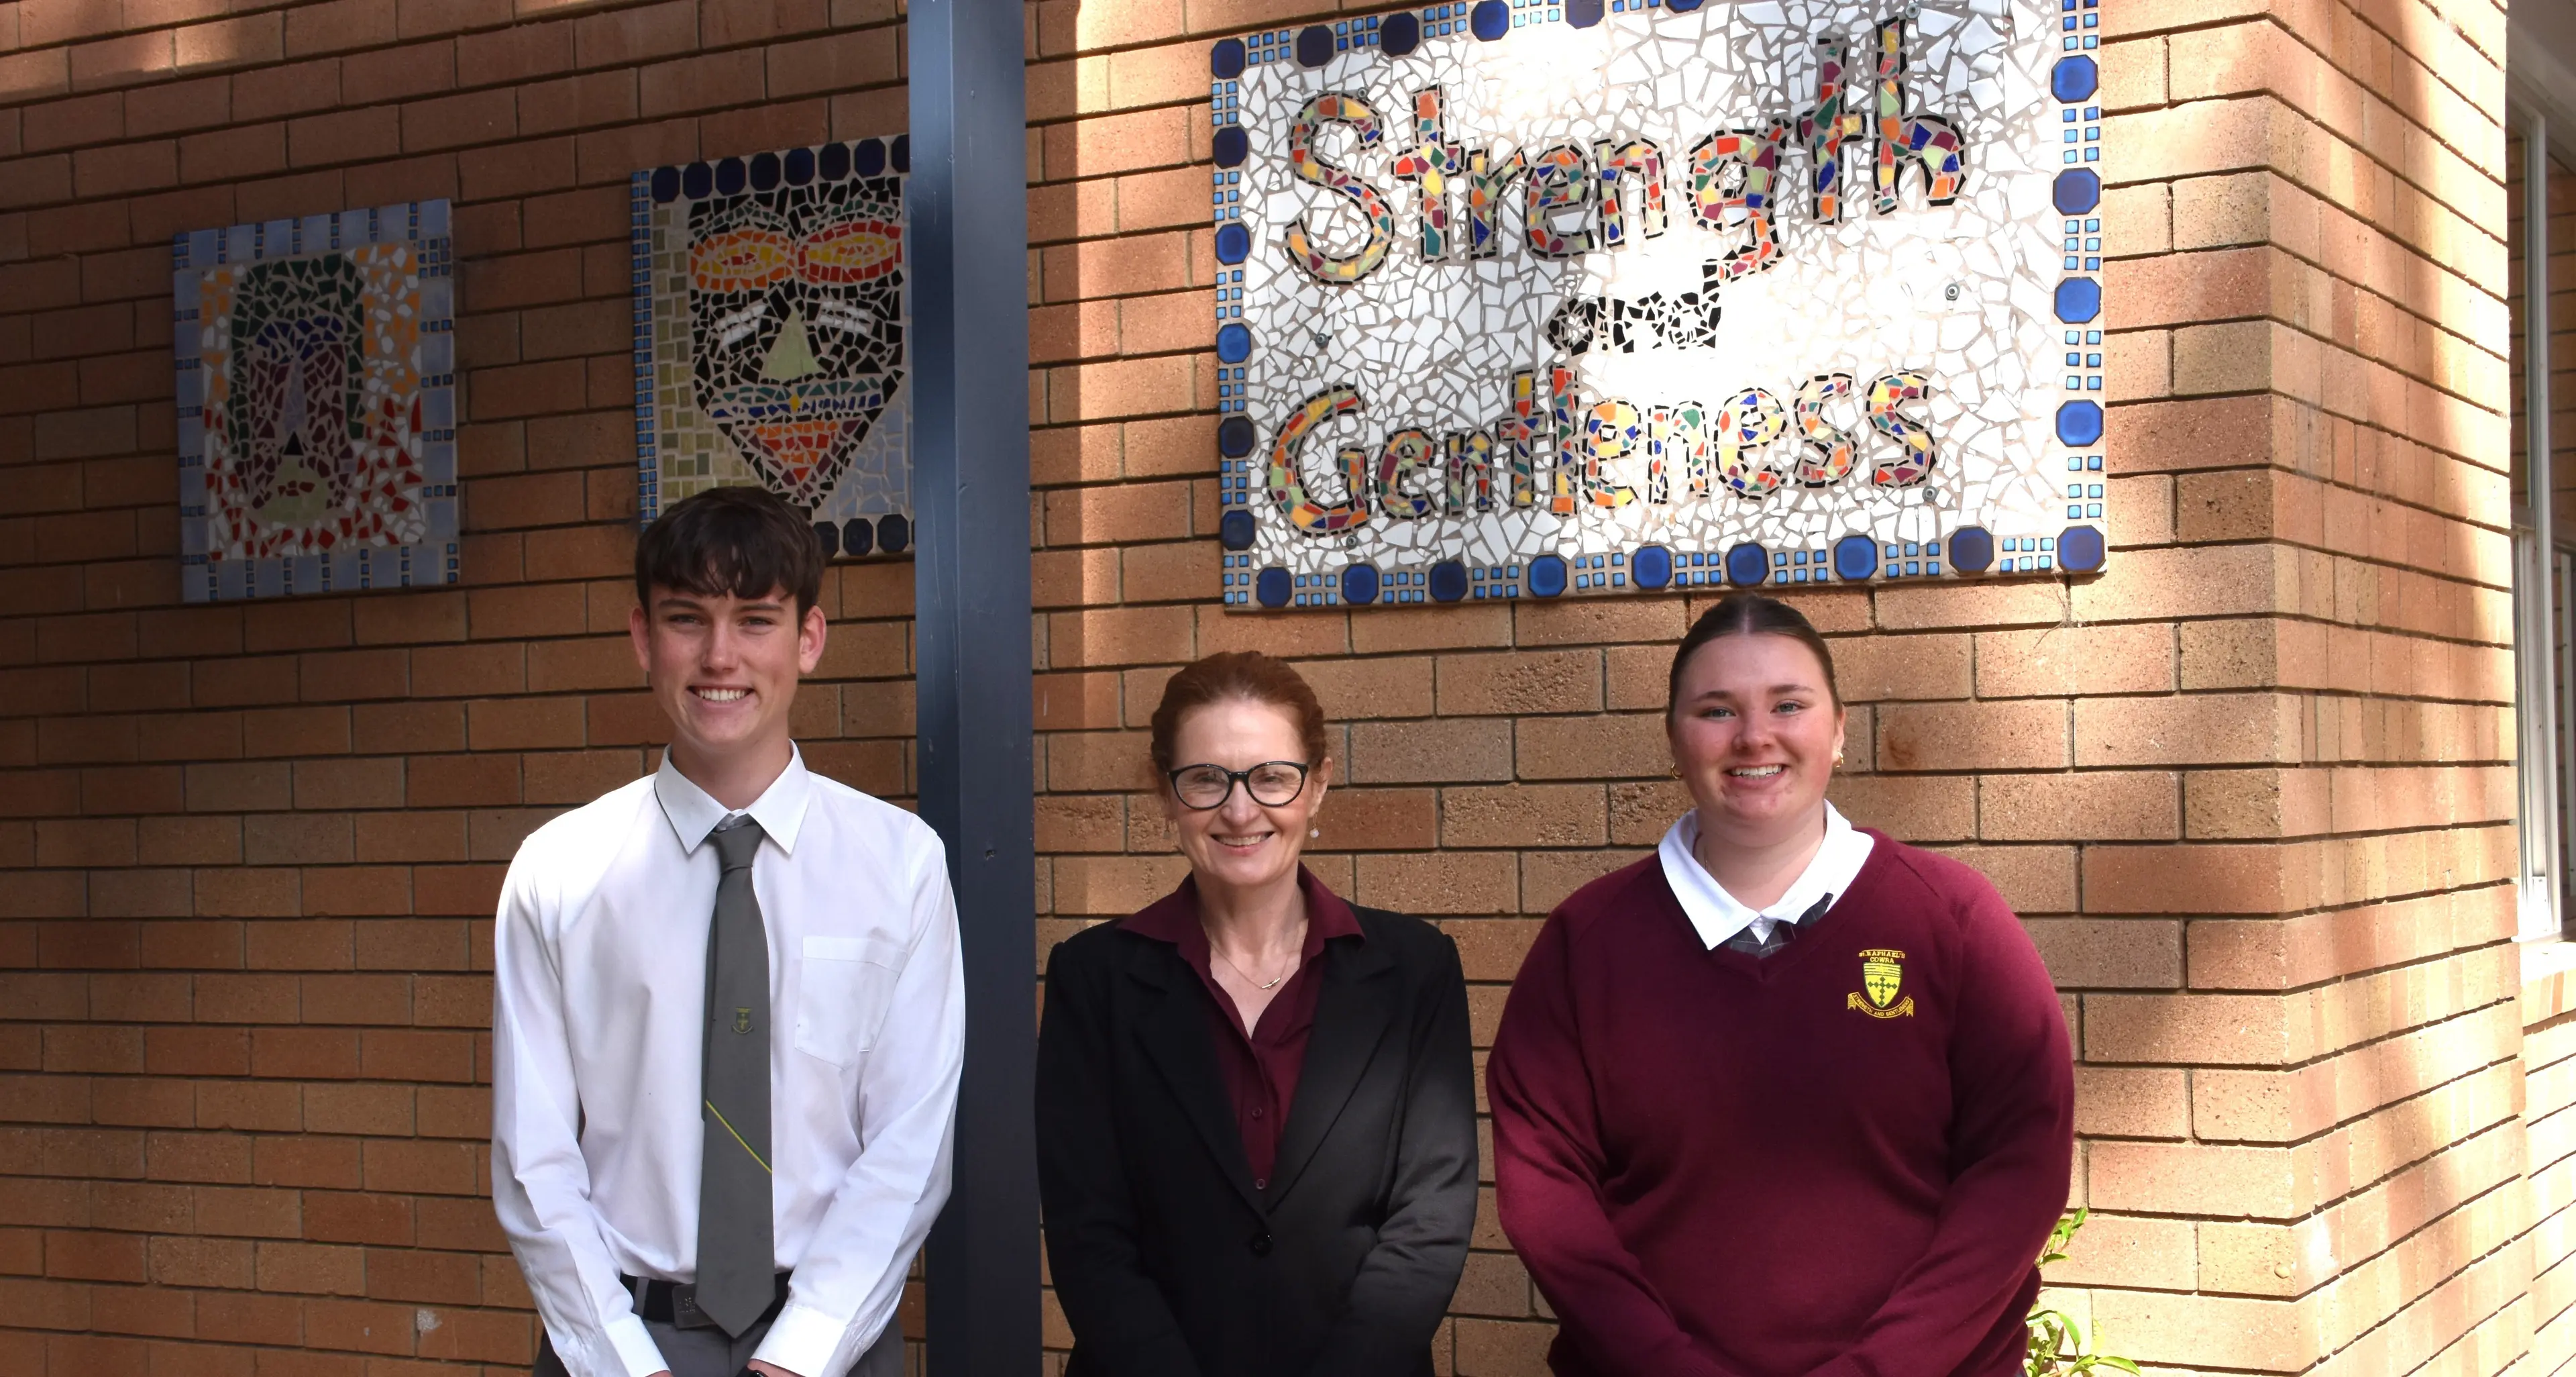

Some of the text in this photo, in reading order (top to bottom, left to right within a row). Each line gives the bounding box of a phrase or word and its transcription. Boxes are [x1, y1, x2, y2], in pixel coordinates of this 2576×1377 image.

[1285, 15, 1966, 286] Strength
[1548, 258, 1722, 356] and
[1267, 364, 1937, 536] Gentleness
